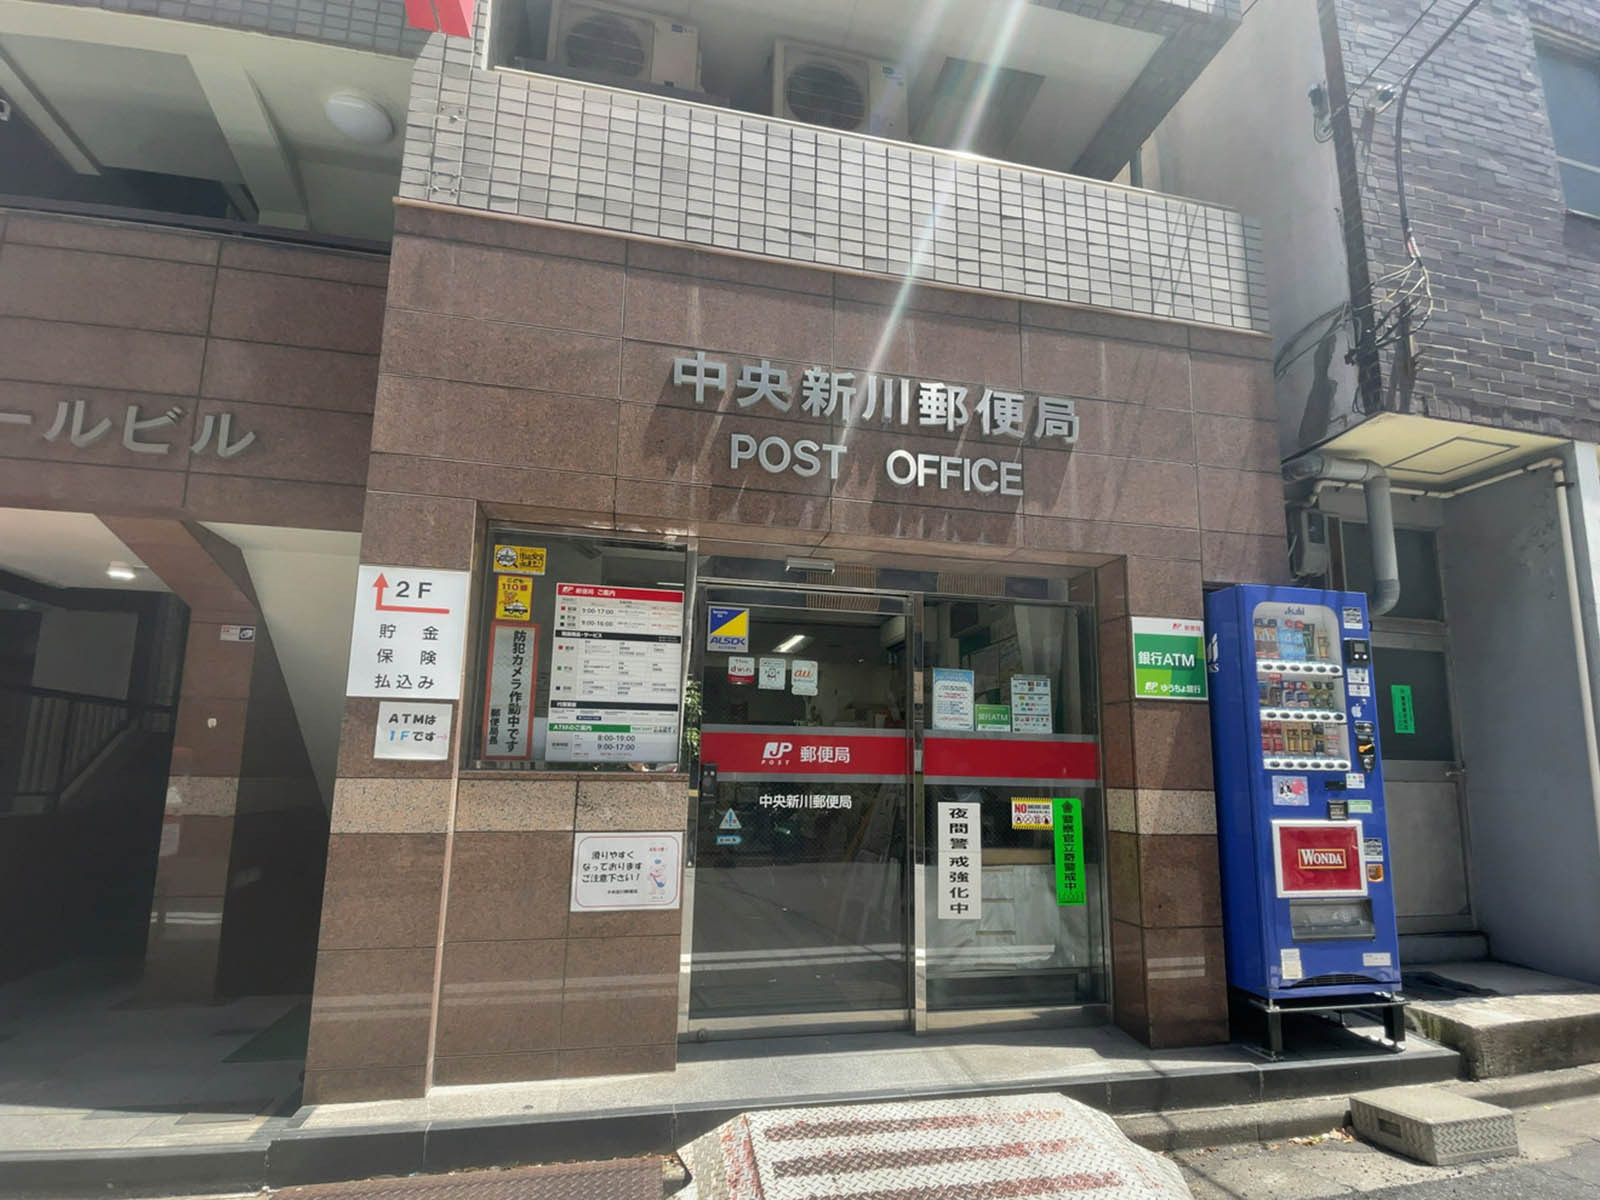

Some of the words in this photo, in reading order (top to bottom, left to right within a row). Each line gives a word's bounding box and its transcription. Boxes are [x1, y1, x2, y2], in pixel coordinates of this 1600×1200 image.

[673, 352, 1080, 443] 中央新川郵便局
[0, 400, 256, 458] ールビル
[729, 433, 847, 480] POST
[886, 449, 1024, 497] OFFICE
[395, 581, 433, 599] 2F
[710, 636, 745, 646] ALSOK
[1138, 651, 1195, 667] 銀行ATM
[374, 674, 434, 690] 払込み
[505, 629, 527, 753] 防犯カメラ作動中です
[388, 713, 437, 725] ATMは
[597, 743, 635, 751] 9:00-17:00
[800, 745, 850, 763] 郵便局
[759, 794, 852, 809] 中央新川郵便局
[1014, 803, 1027, 814] NO
[592, 850, 634, 860] 滑りやすく
[949, 807, 969, 914] 夜間警戒強化中
[1302, 849, 1343, 866] WONDA
[582, 862, 642, 871] なっております
